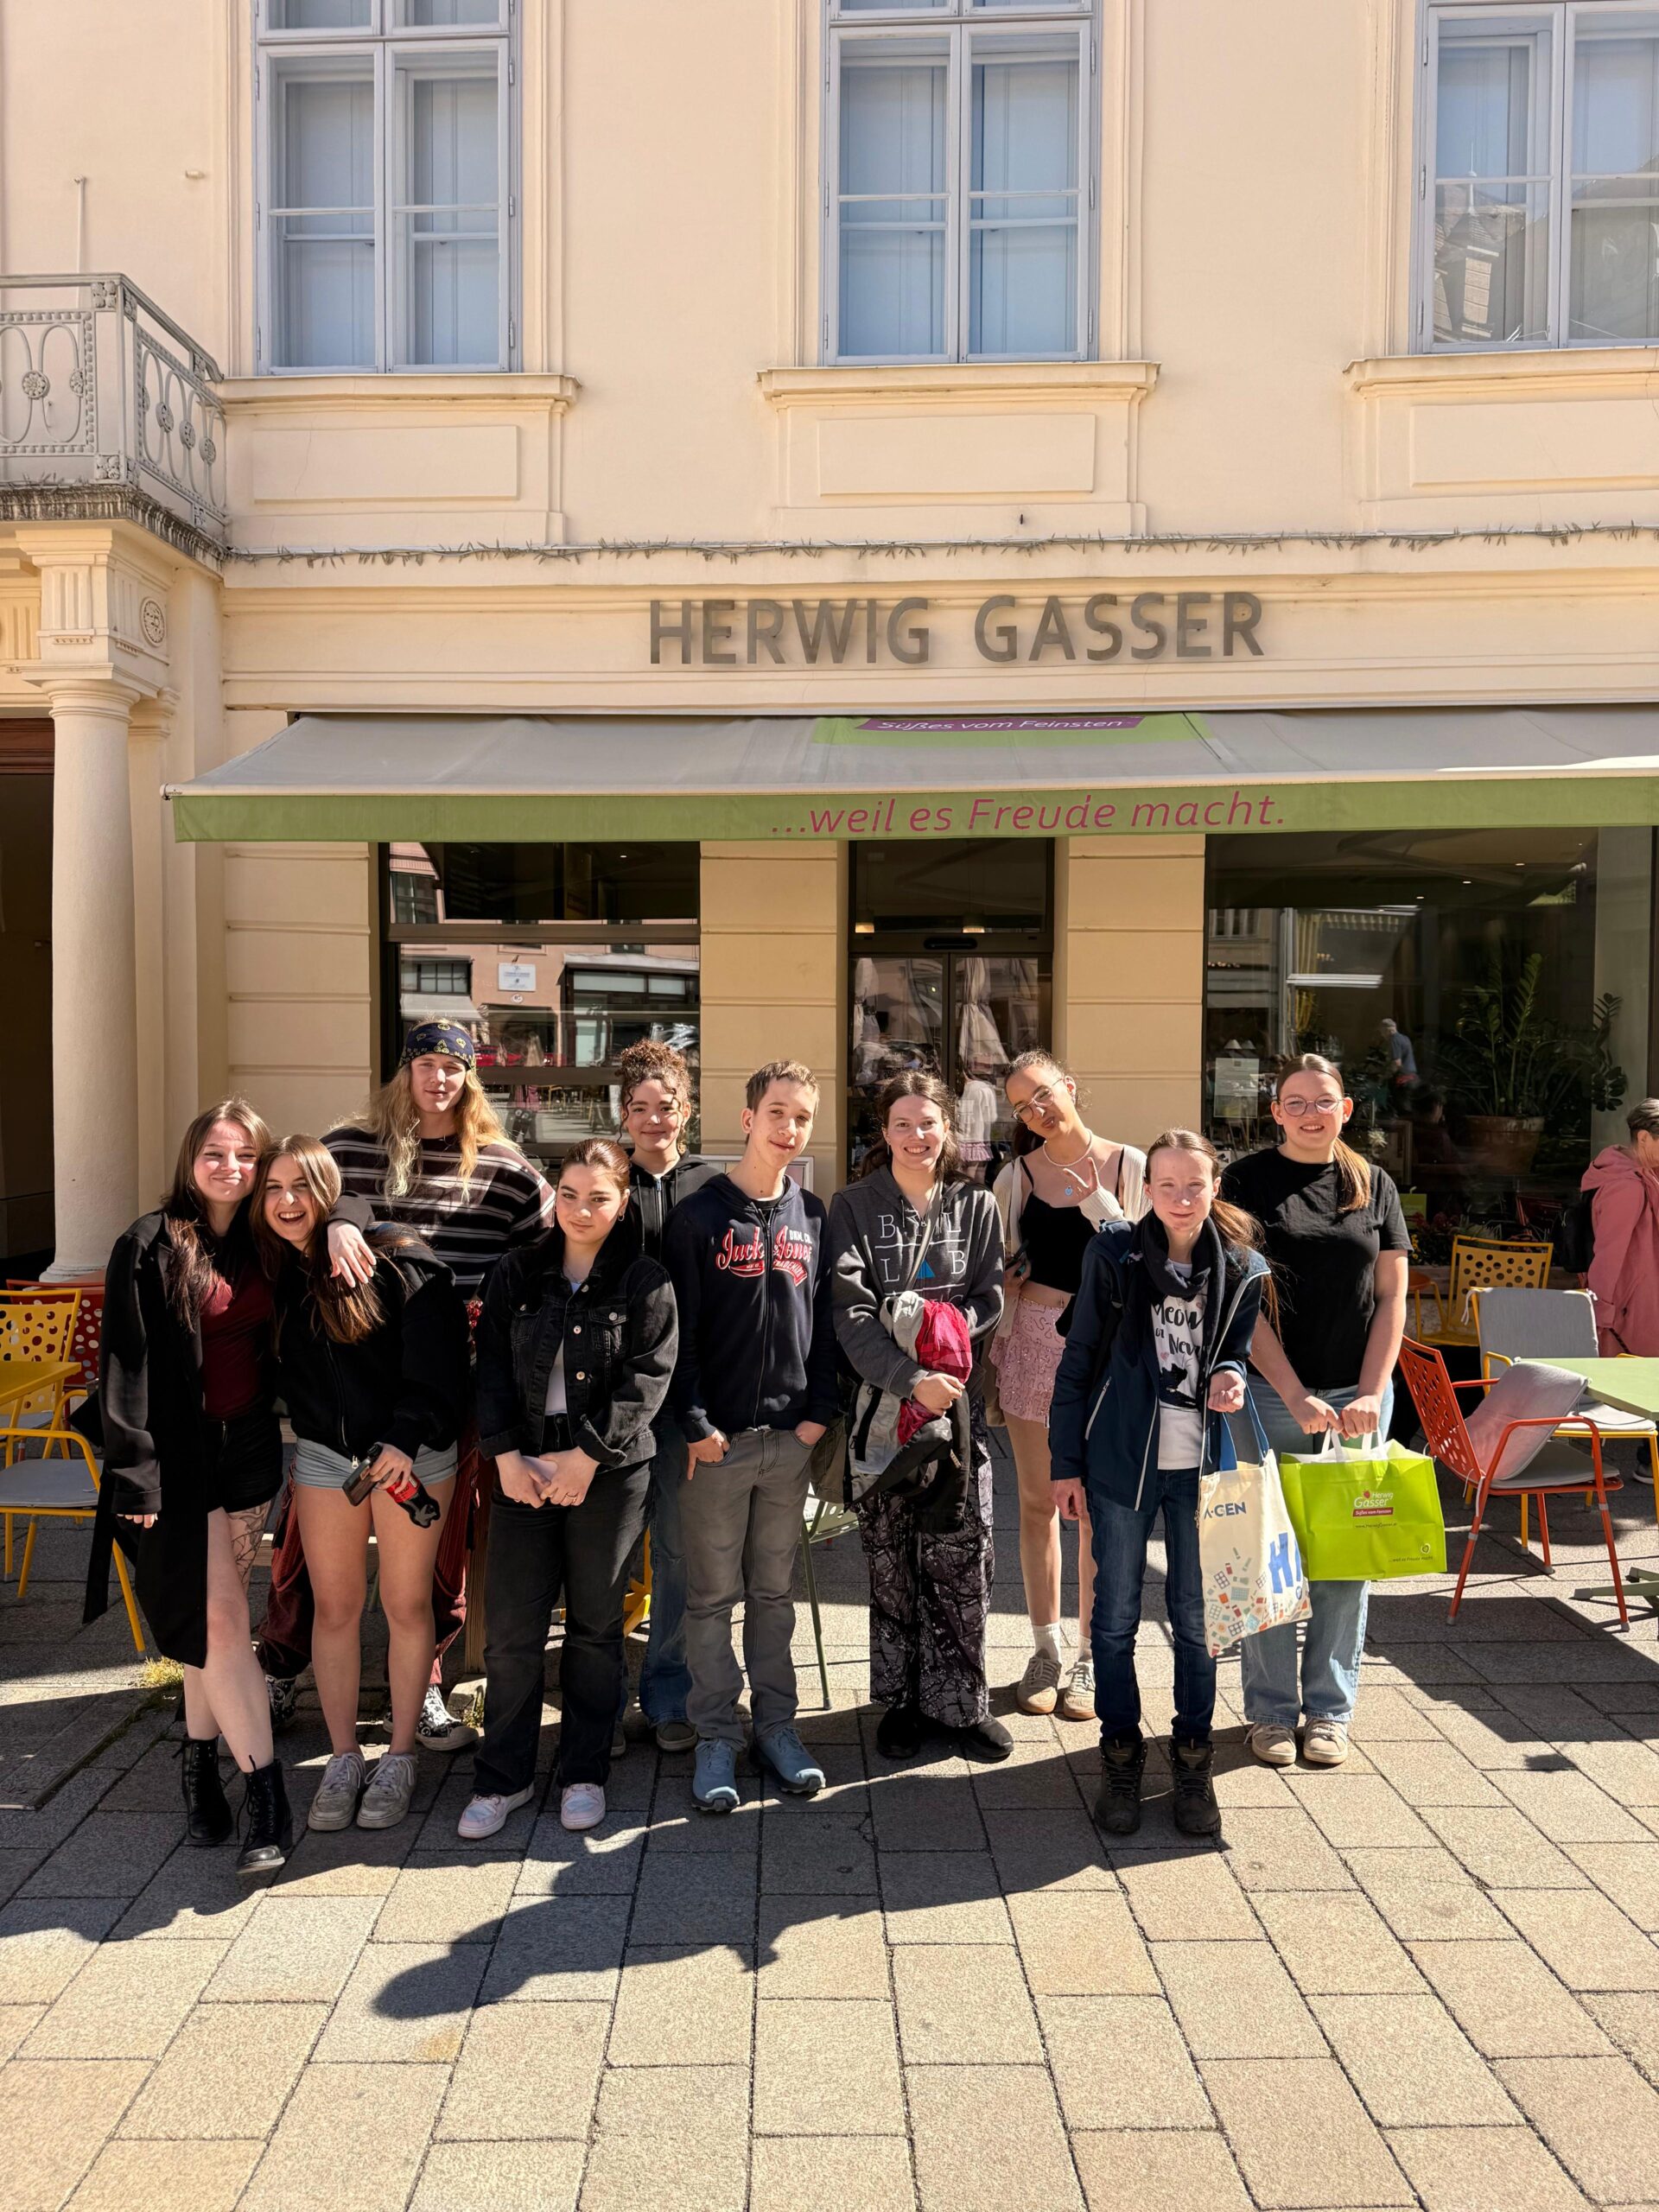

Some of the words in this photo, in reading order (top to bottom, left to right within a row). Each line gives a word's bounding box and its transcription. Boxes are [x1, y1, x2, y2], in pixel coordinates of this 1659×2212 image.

[651, 597, 930, 664] HERWIG
[975, 592, 1265, 663] GASSER
[877, 721, 953, 730] Süßes
[1019, 720, 1123, 728] Feinsten
[910, 806, 952, 833] es
[969, 795, 1116, 831] Freude
[1131, 791, 1286, 827] macht.
[1153, 1303, 1205, 1330] Meow
[1354, 1497, 1389, 1508] Gasser
